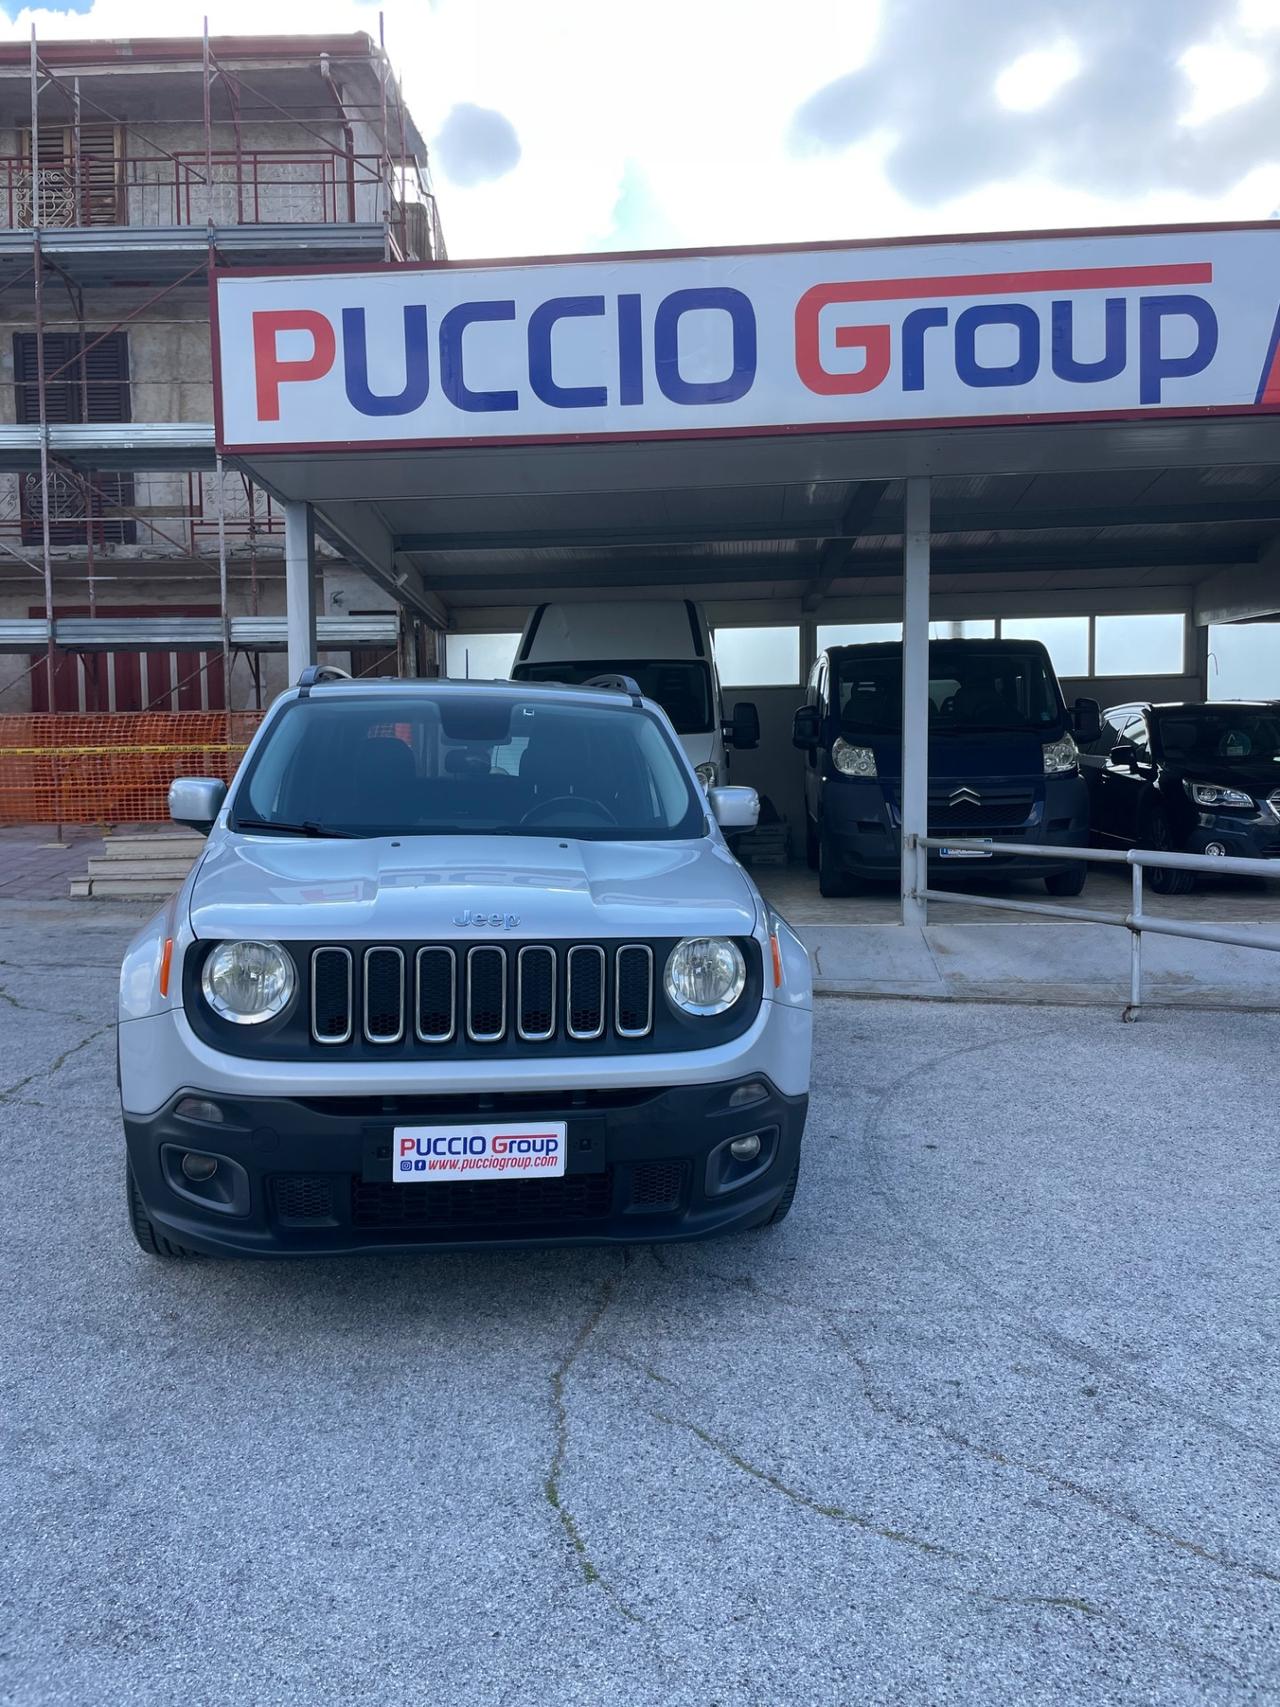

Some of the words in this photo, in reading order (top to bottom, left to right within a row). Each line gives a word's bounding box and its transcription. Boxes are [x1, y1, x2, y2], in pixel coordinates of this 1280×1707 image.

[252, 286, 757, 422] PUCCIO
[794, 262, 1219, 405] Group
[452, 909, 521, 931] Jeep
[400, 1136, 487, 1157] PUCCIO
[491, 1134, 559, 1156] Group
[428, 1155, 558, 1172] www.pucciogroup.com
